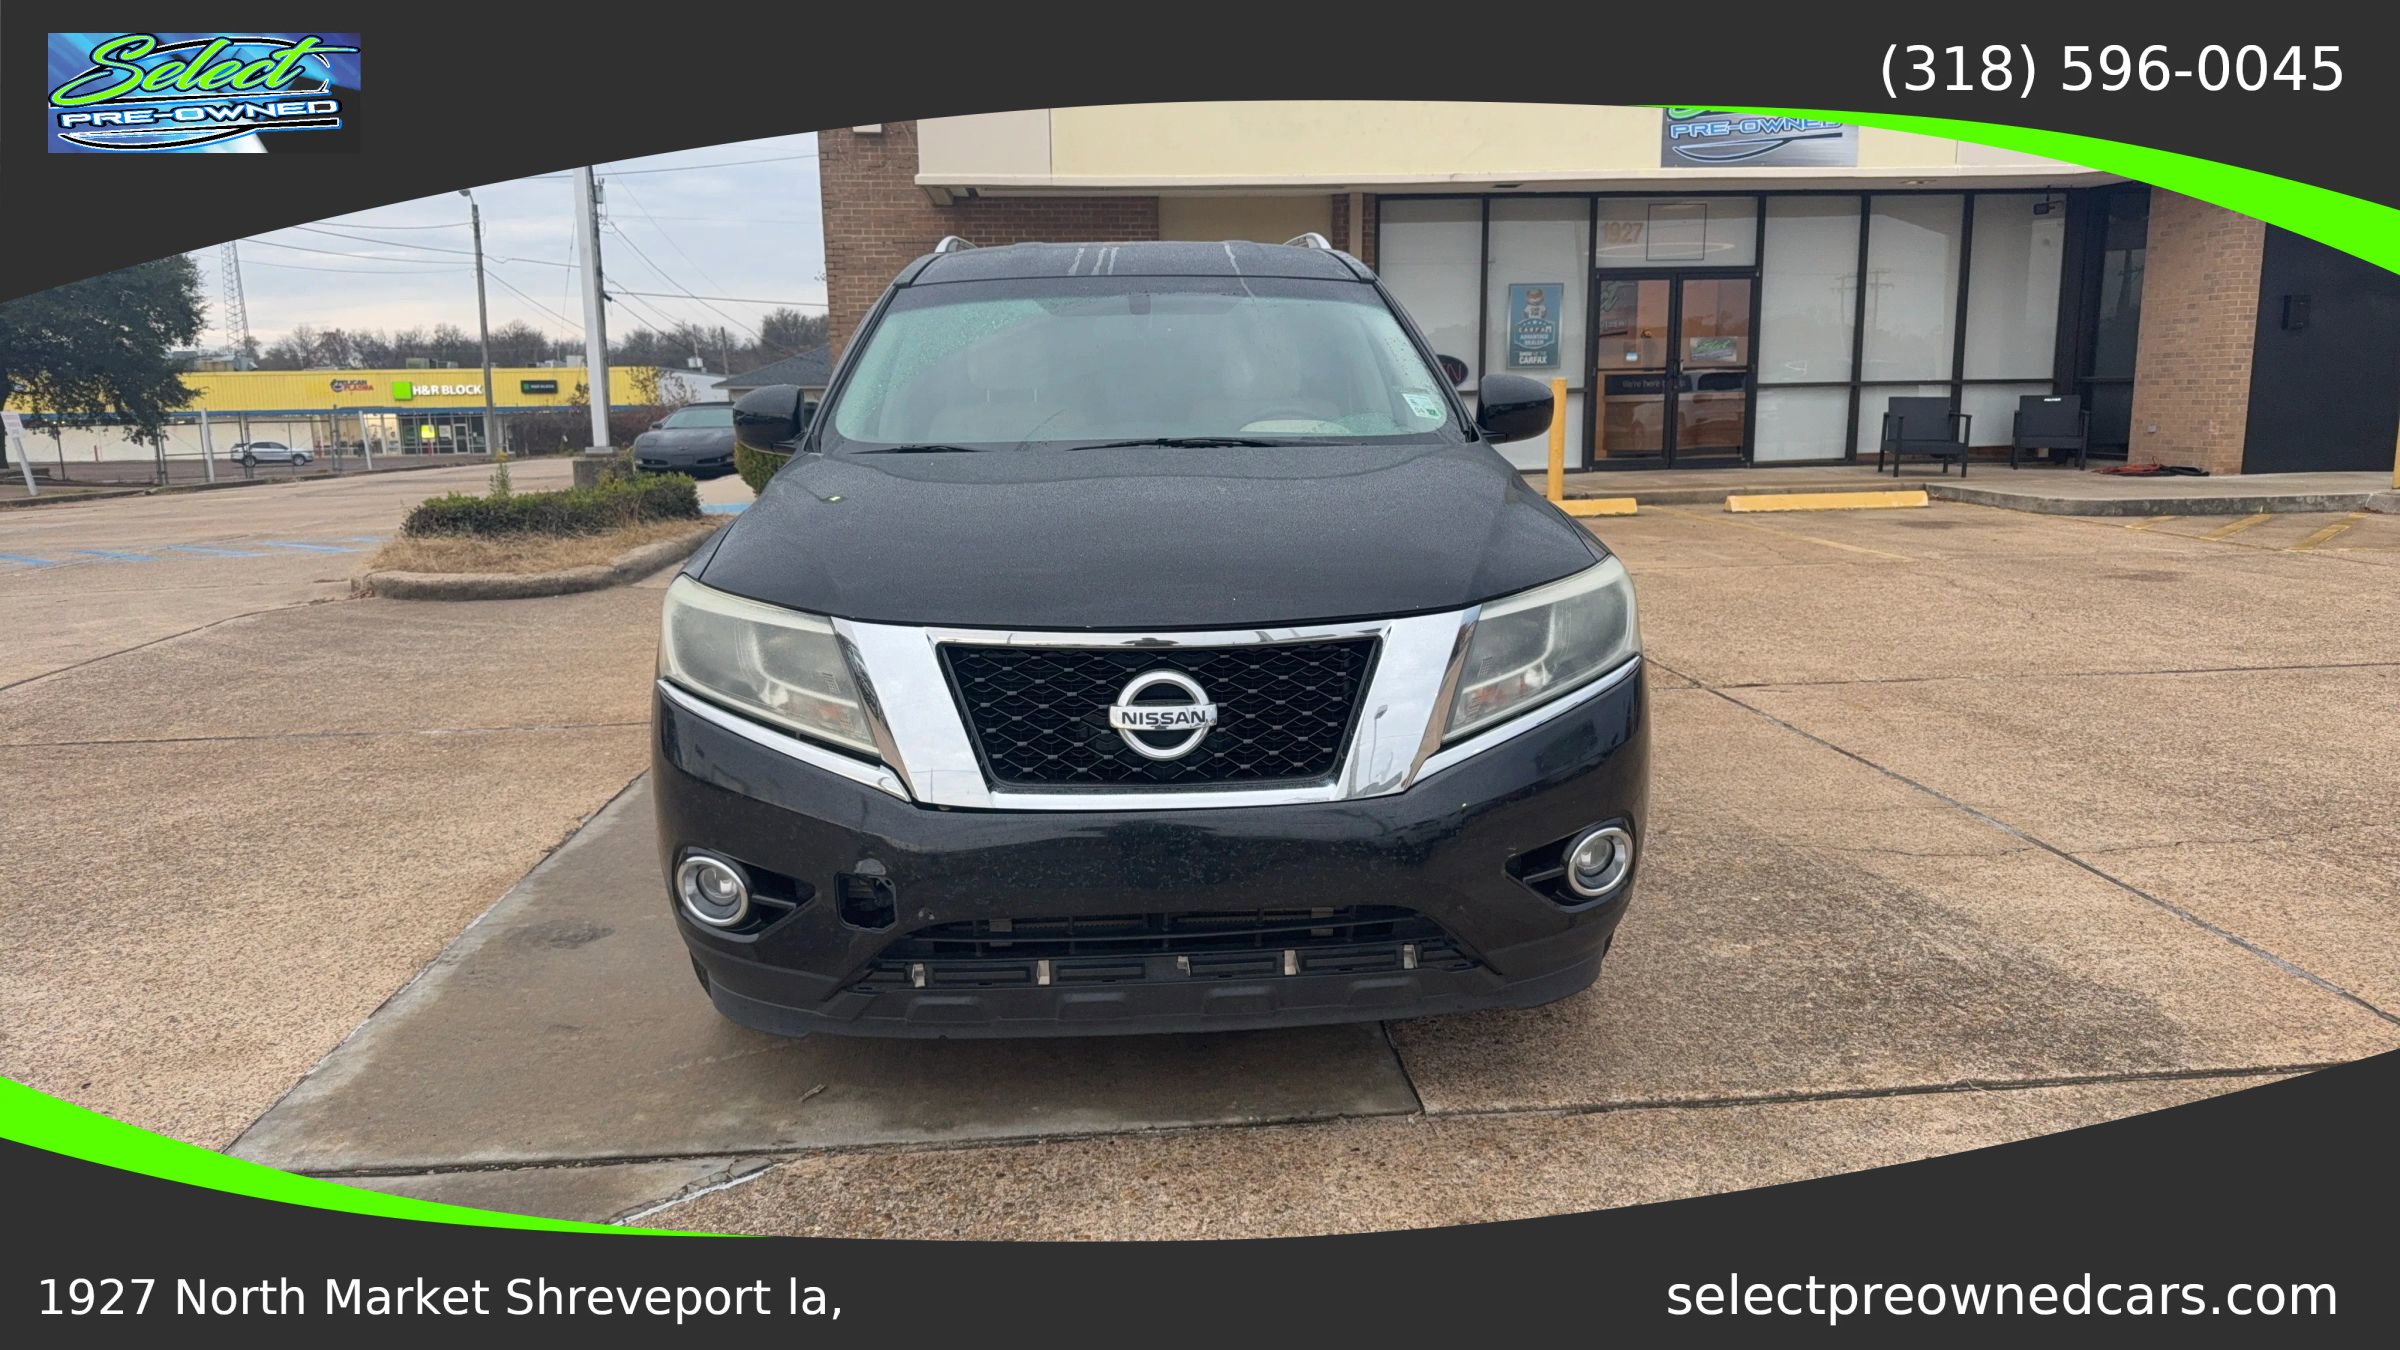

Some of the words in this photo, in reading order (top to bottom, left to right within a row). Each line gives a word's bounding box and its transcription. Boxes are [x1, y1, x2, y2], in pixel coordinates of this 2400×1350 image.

[1603, 222, 1644, 243] 1927
[1519, 356, 1547, 364] CARFAX
[412, 384, 440, 396] H&R
[441, 384, 484, 396] BLOCK
[1121, 710, 1206, 726] NISSAN
